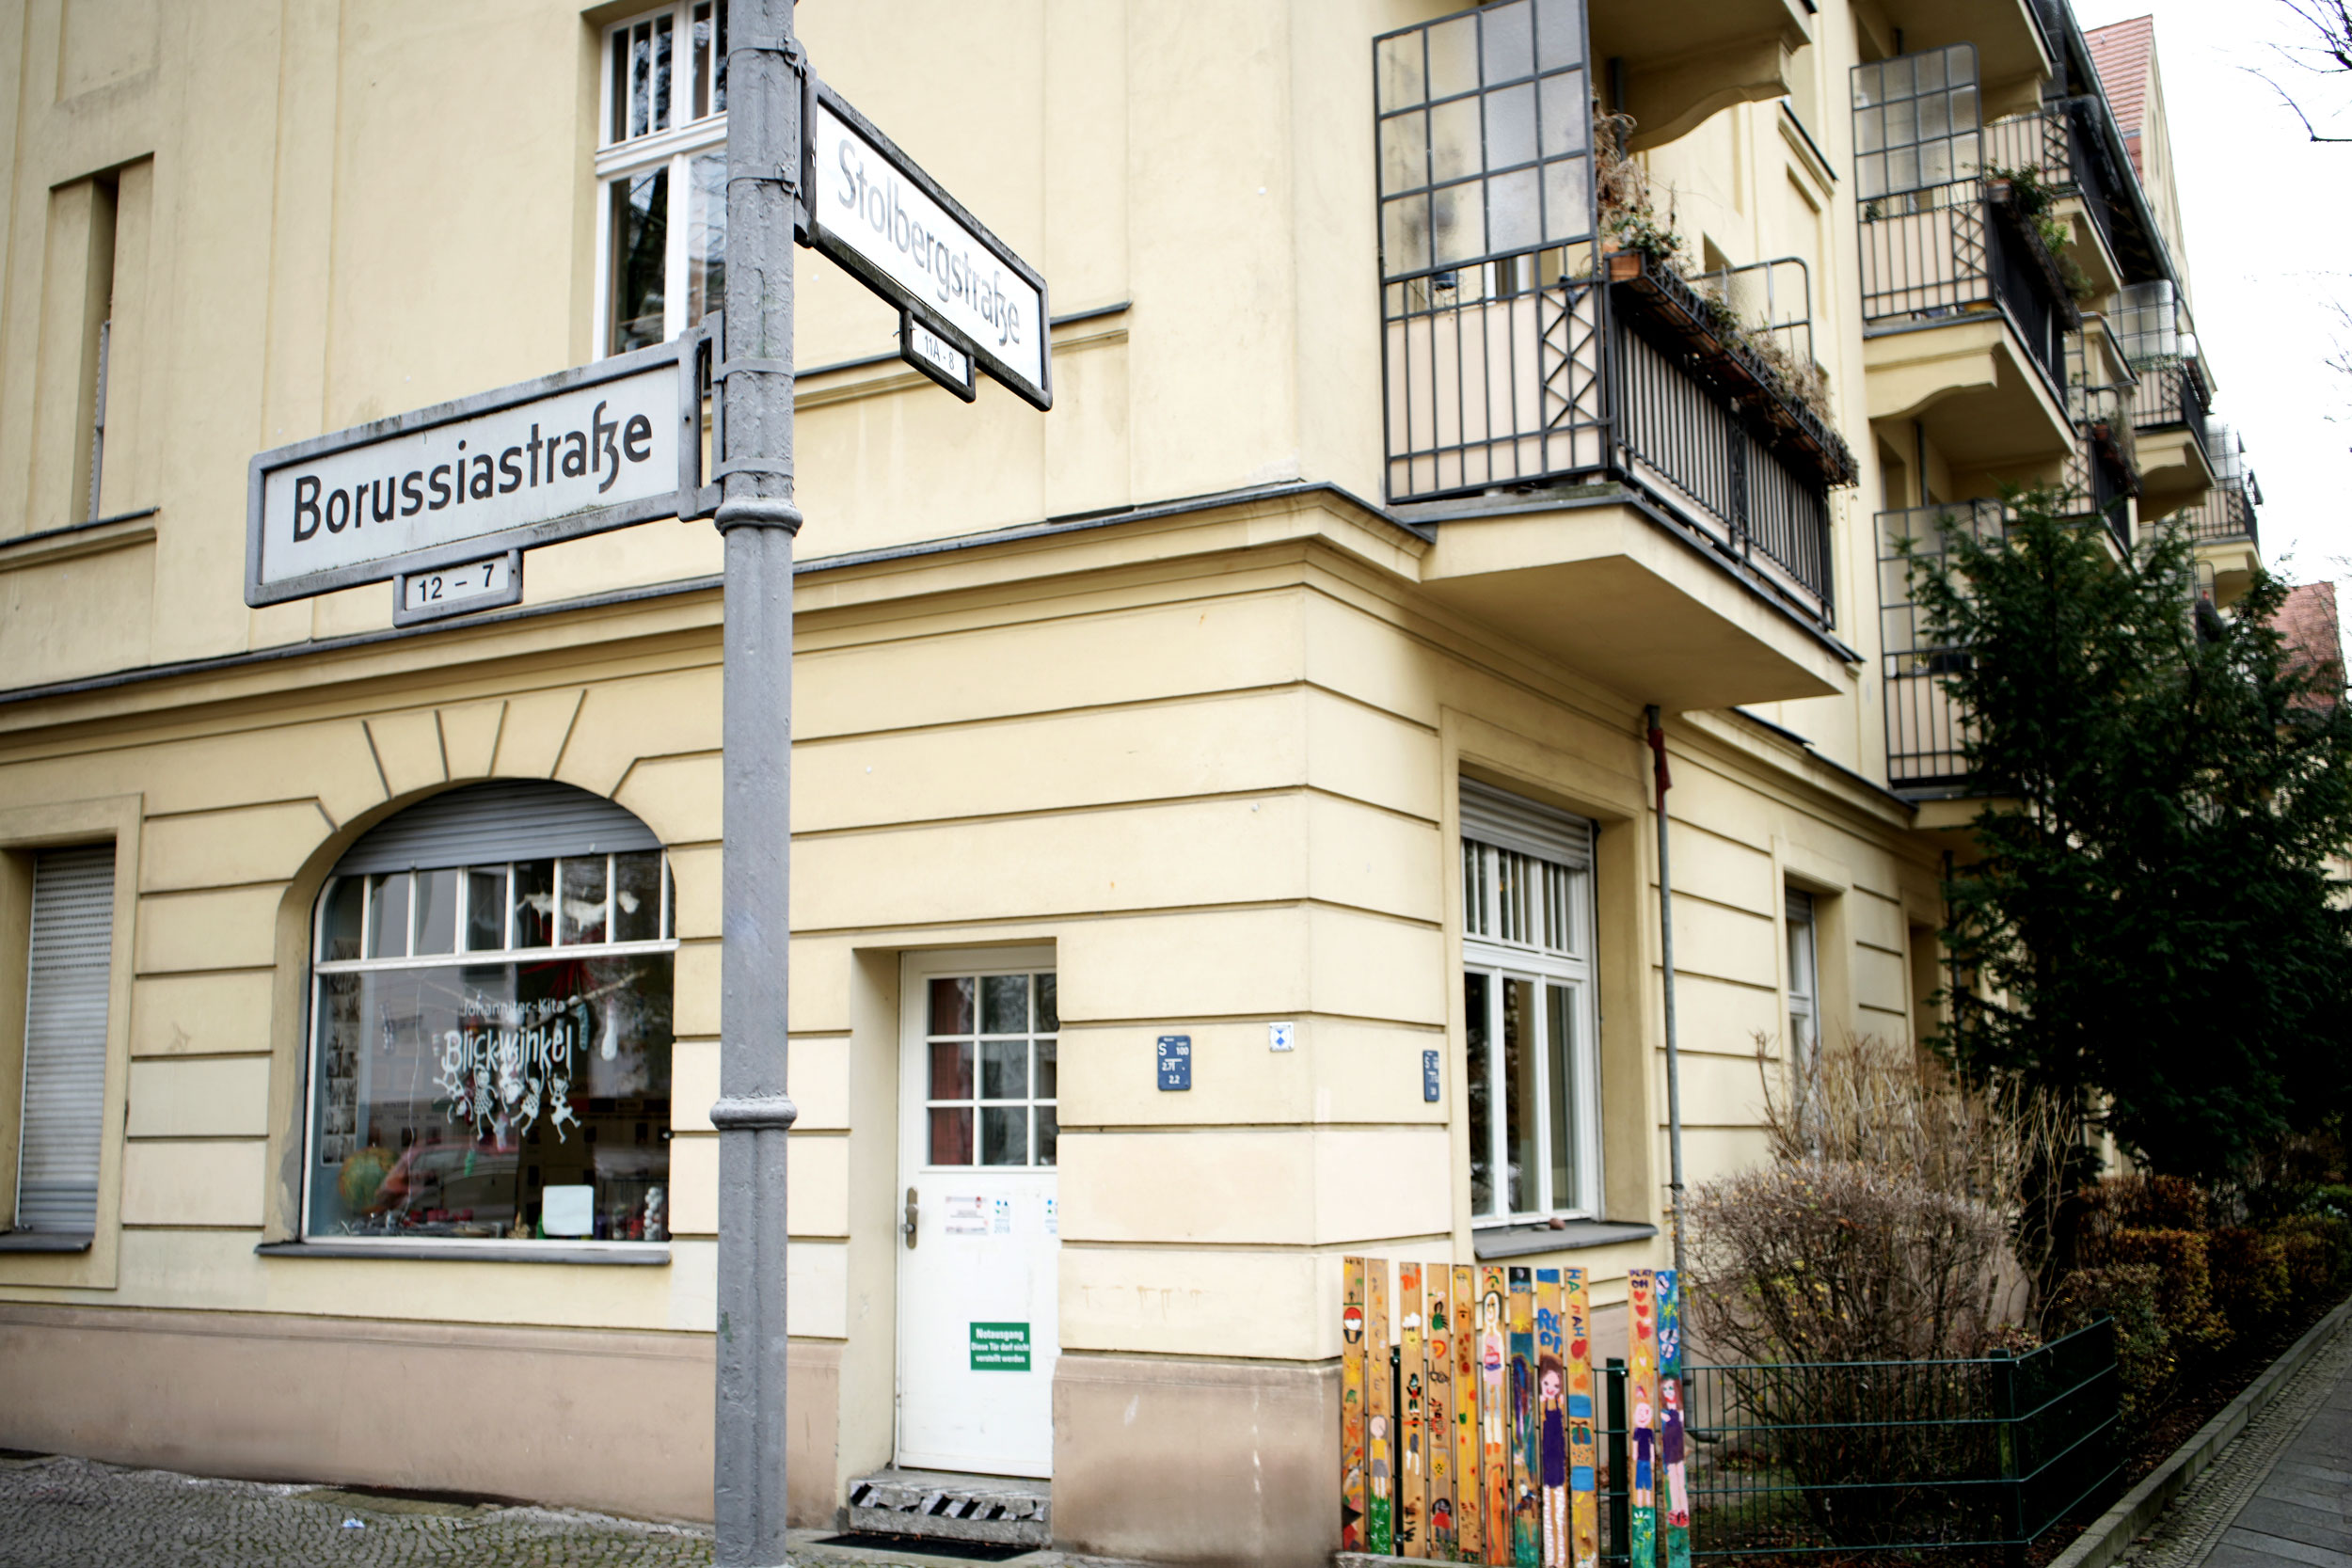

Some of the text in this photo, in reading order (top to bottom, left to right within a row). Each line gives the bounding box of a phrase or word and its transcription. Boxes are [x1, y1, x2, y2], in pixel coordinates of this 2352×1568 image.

[838, 139, 1020, 347] Stolbergstraße
[925, 335, 940, 362] 11A
[948, 351, 955, 371] 8
[293, 401, 653, 543] Borussiastraße
[419, 576, 443, 602] 12
[483, 563, 495, 588] 7
[441, 1024, 572, 1073] Blickwinkel
[1158, 1042, 1168, 1056] S
